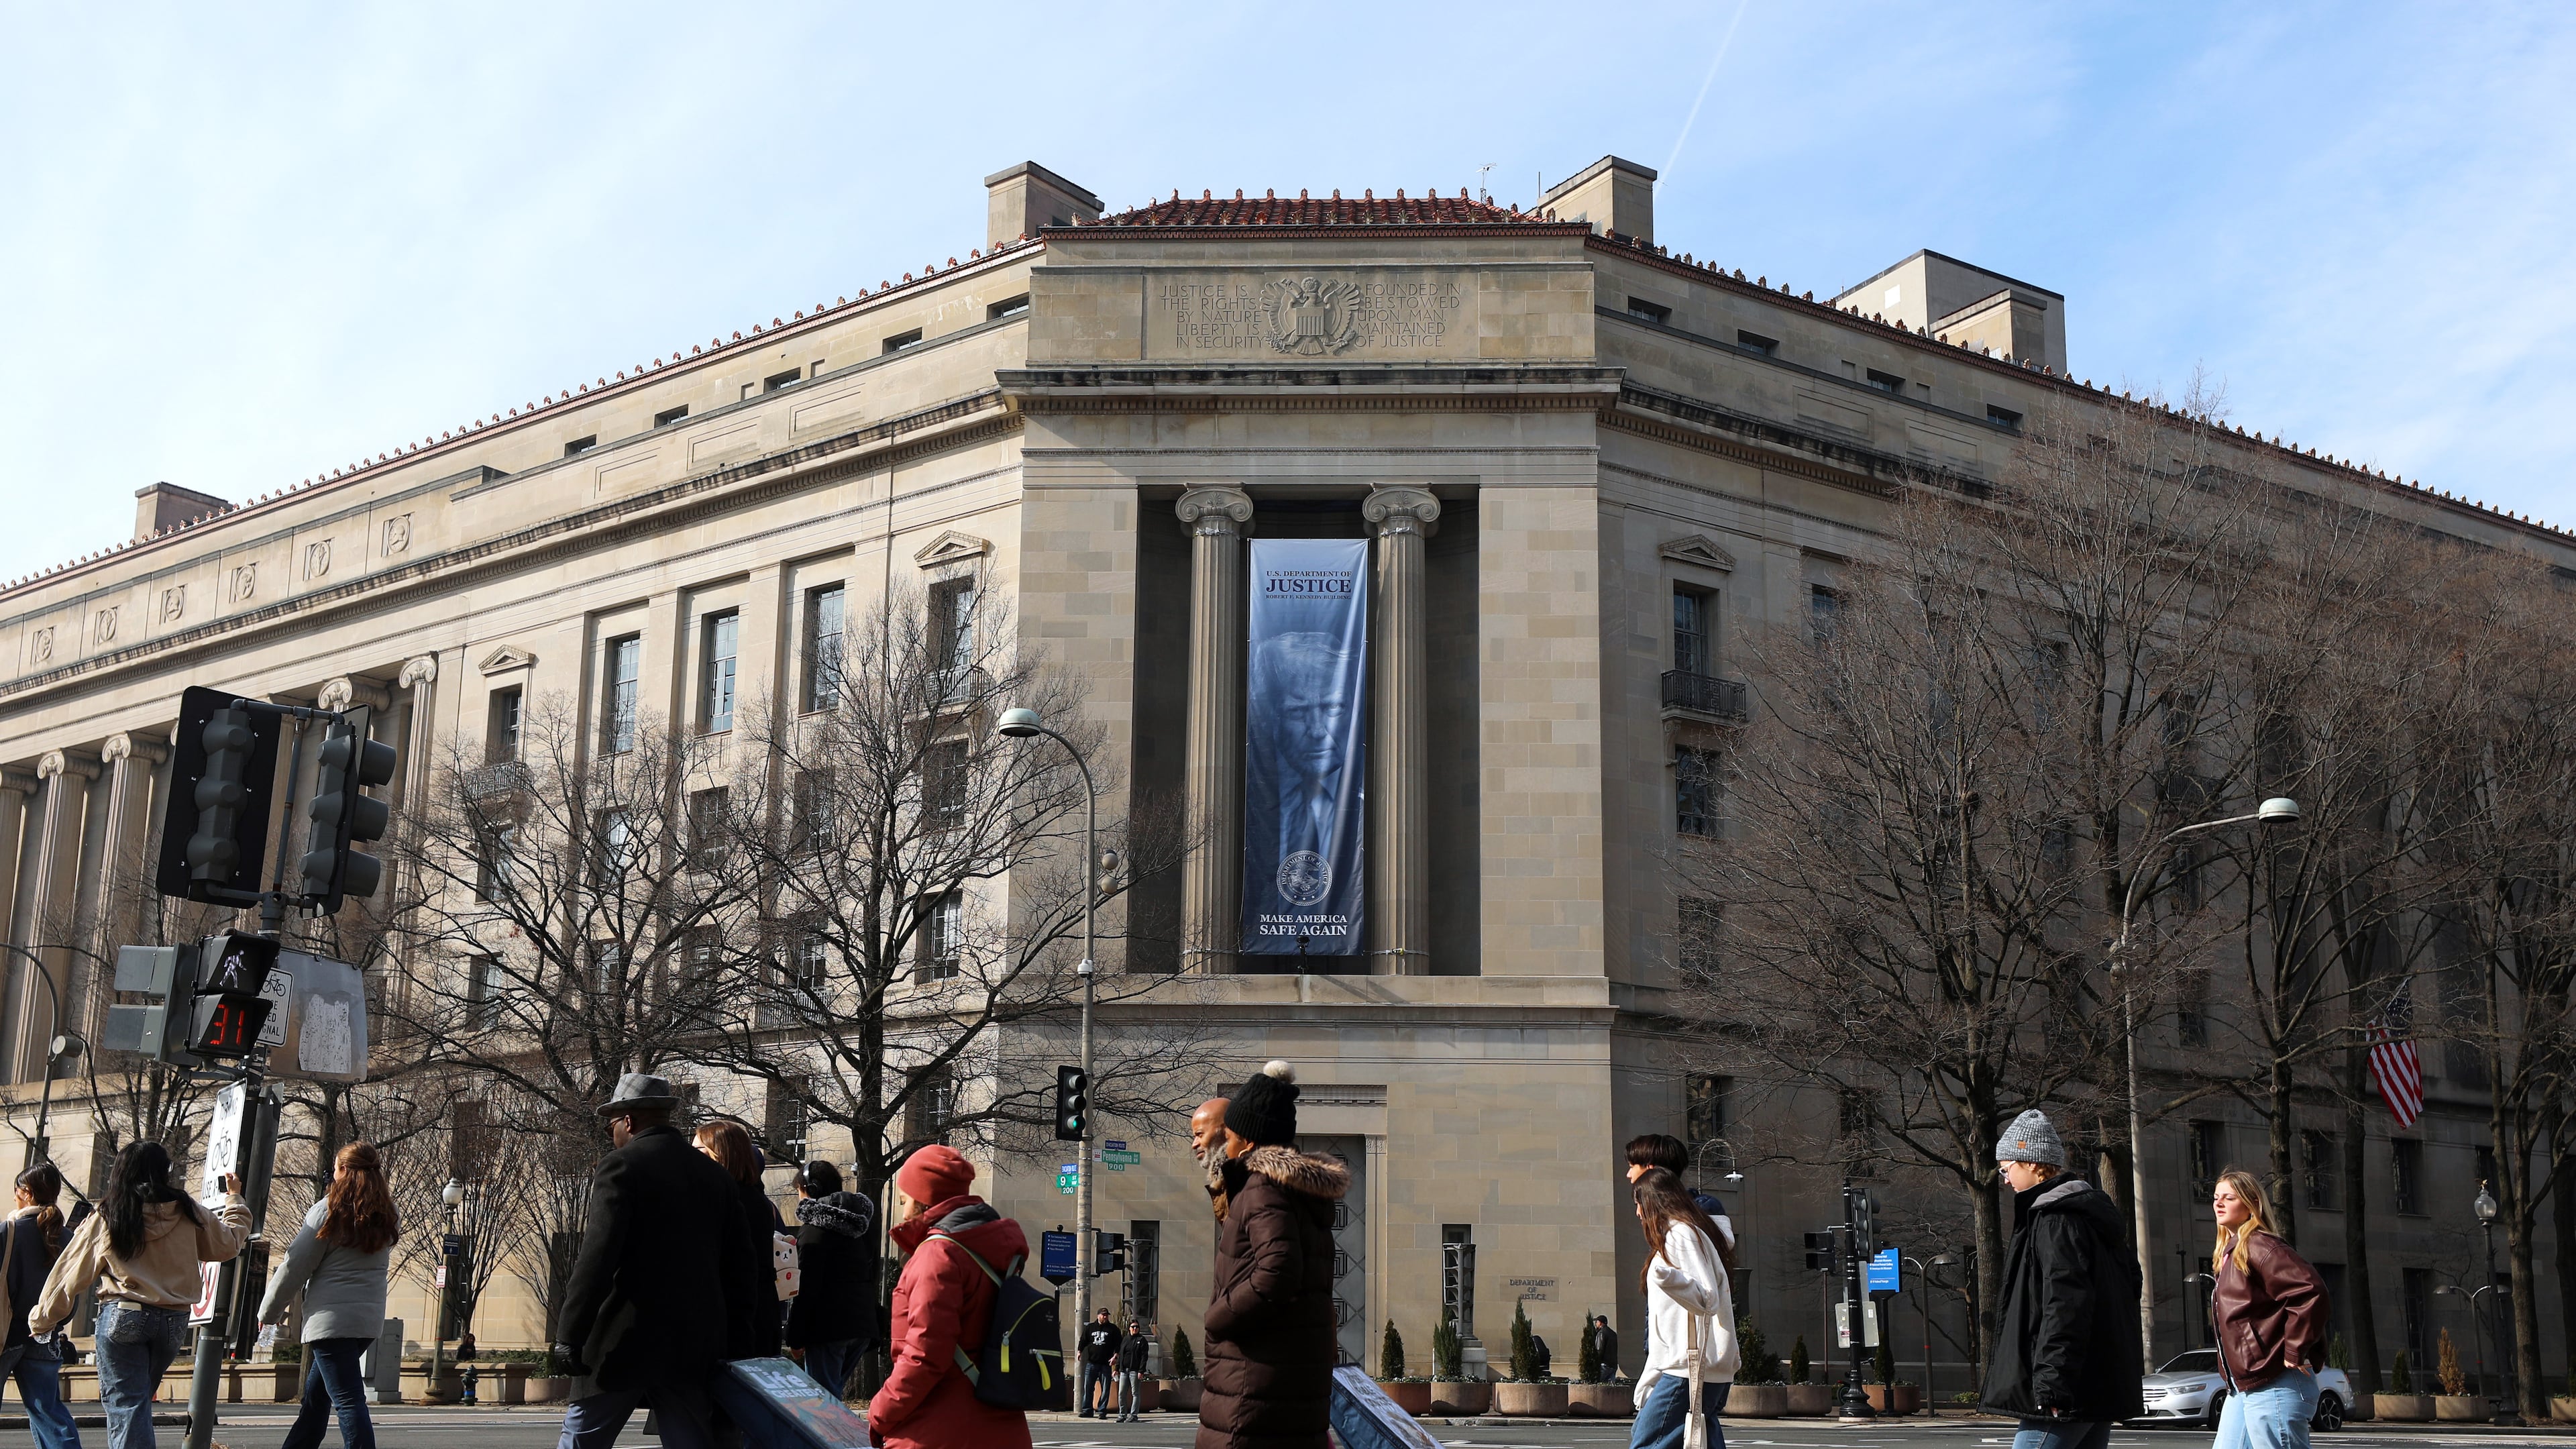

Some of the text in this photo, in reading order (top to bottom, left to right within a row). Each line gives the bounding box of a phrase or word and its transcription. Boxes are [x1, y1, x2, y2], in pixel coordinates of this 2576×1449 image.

[1159, 283, 1460, 297] JUSTICE IS FOUNDED IN
[1161, 297, 1460, 310] THE RIGHTS BESTOWED
[1177, 309, 1446, 323] BY NATURE UPON MAN.
[1177, 323, 1446, 335] LIBERTY IS MAINTAINED
[1177, 335, 1446, 348] IN SECURITY OF JUSTICE.
[1266, 579, 1351, 592] JUSTICE
[1281, 855, 1307, 885] DEPARTMENT
[1316, 862, 1328, 885] JUSTICE
[1260, 914, 1347, 923] MAKE AMERICA
[1260, 925, 1347, 936] SAFE AGAIN
[268, 1012, 276, 1022] ED
[210, 1004, 245, 1046] 31
[262, 1022, 280, 1036] GNAL
[1102, 1150, 1132, 1163] Pennsylvania
[1060, 1176, 1066, 1186] 9
[749, 1371, 808, 1389] Life
[769, 1388, 825, 1398] CREATED?
